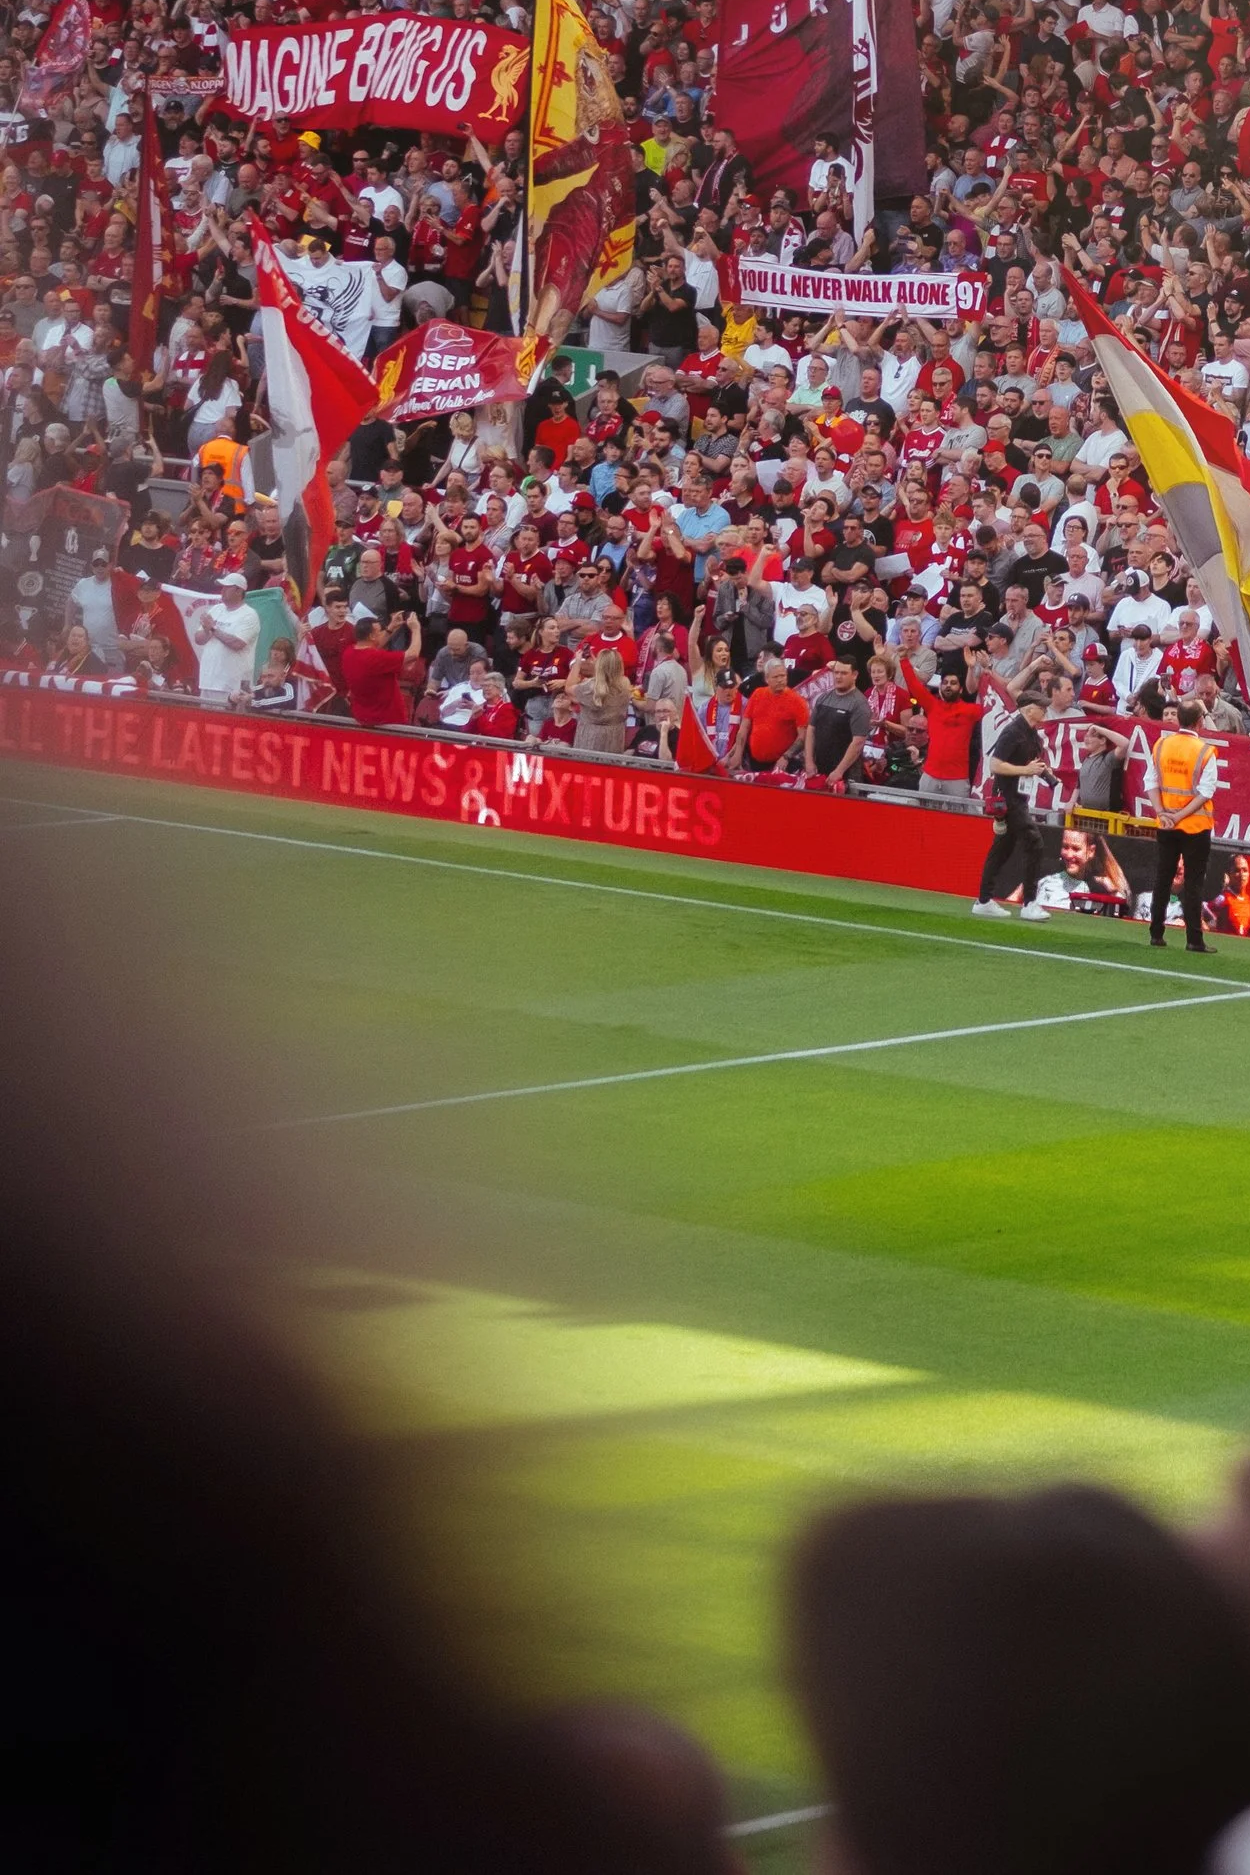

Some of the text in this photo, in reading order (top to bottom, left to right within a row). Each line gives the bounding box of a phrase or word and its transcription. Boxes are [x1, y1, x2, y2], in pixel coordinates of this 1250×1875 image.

[424, 27, 487, 113] US
[740, 269, 768, 294] YOU
[791, 275, 843, 302] NEVER
[846, 277, 893, 304] WALK
[897, 280, 951, 307] ALONE
[957, 280, 985, 312] 97
[55, 703, 142, 765] THE
[153, 715, 311, 788] LATEST
[322, 740, 447, 807] NEWS
[1117, 727, 1229, 791] AE
